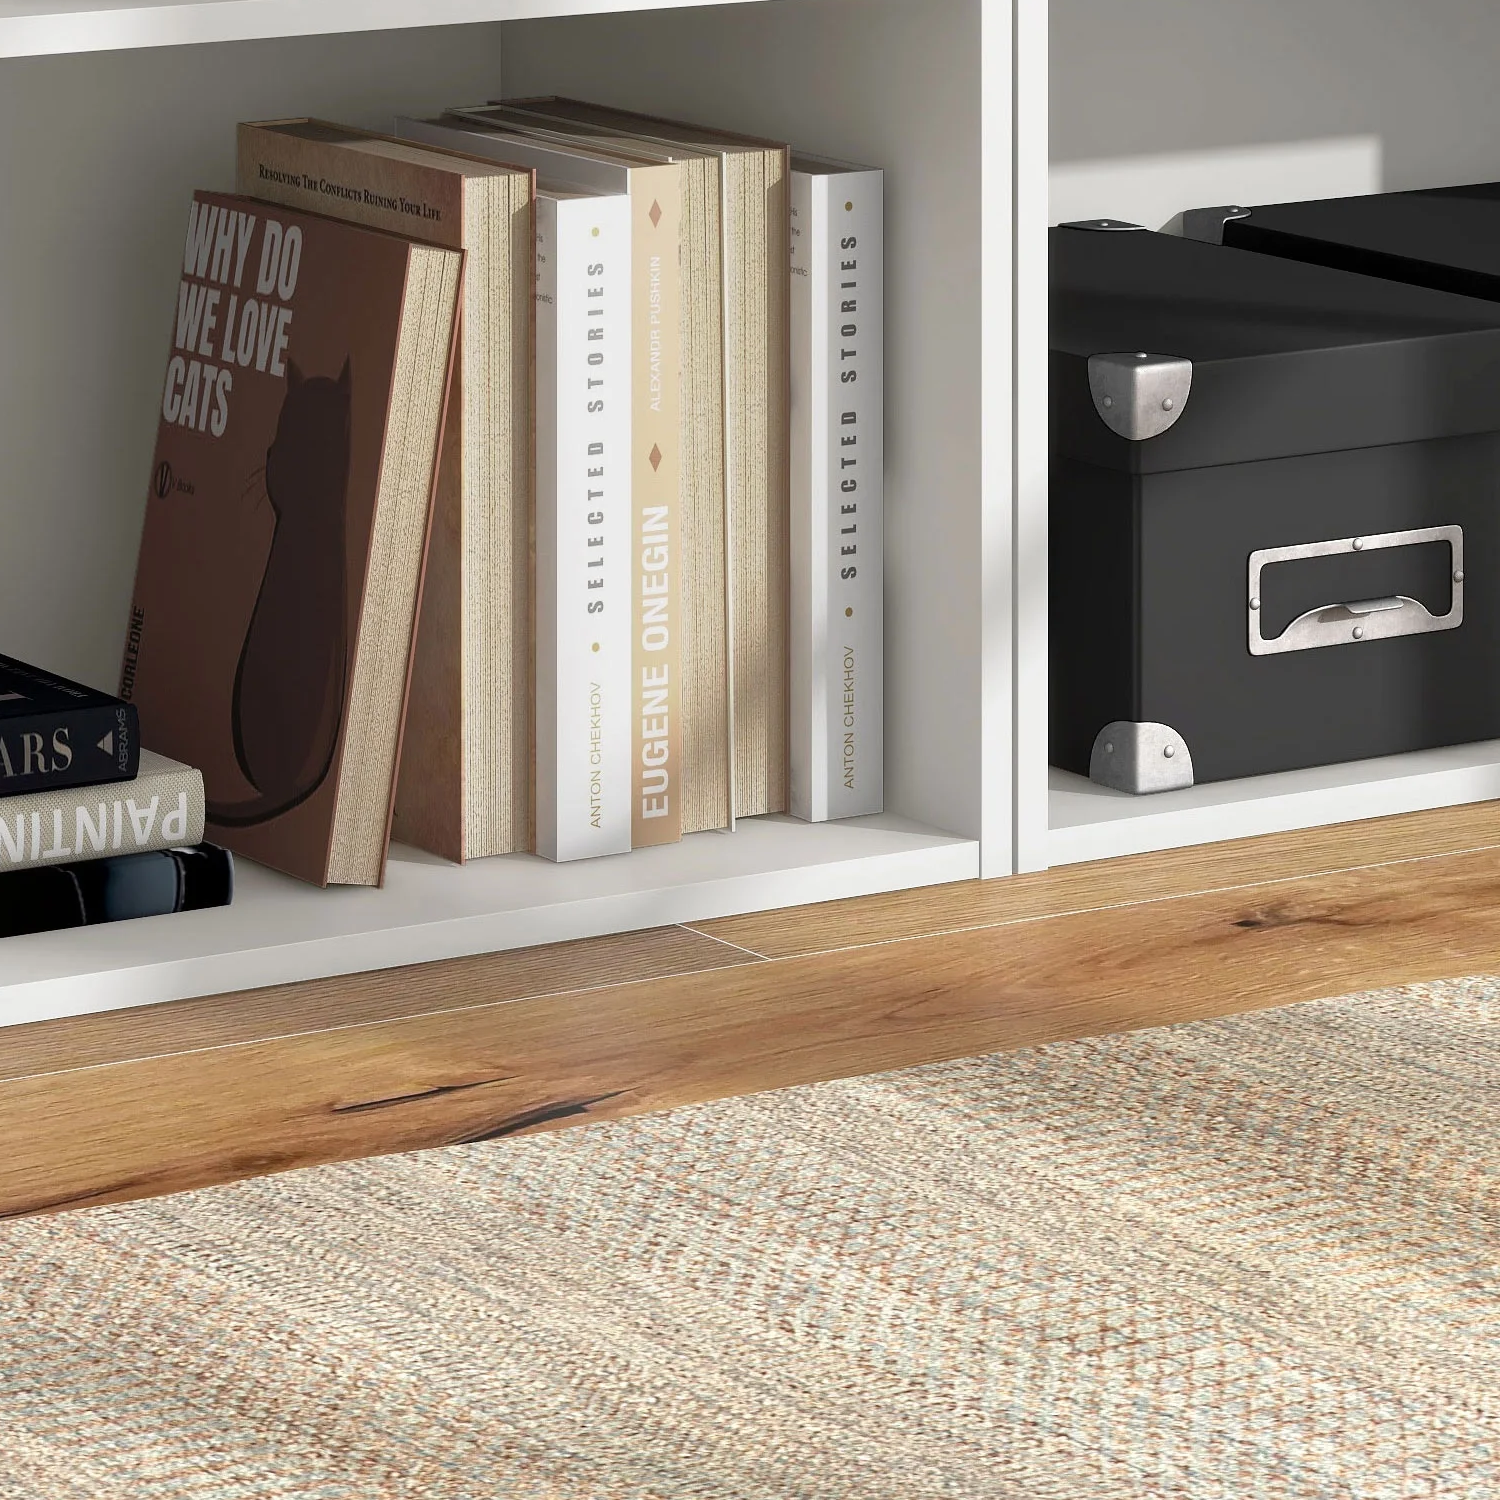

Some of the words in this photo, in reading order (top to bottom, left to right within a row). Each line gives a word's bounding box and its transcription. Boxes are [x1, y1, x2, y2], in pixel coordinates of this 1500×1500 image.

[184, 201, 256, 288] WHY
[256, 219, 303, 301] DO
[650, 256, 661, 324] PUSHKIN
[175, 280, 221, 357] WE
[221, 294, 293, 378] LOVE
[587, 263, 604, 413] STORIES
[841, 235, 857, 383] STORIES
[162, 355, 232, 438] CATS
[650, 328, 661, 412] ALEXANDR
[587, 441, 604, 613] SELECTED
[841, 410, 857, 580] SELECTED
[642, 504, 669, 652] ONEGIN
[590, 681, 601, 765] CHEKHOV
[844, 645, 854, 727] CHEKHOV
[115, 707, 128, 772] ABRAMS
[642, 663, 669, 820] EUGENE
[844, 729, 855, 790] ANTON
[590, 770, 601, 828] ANTON
